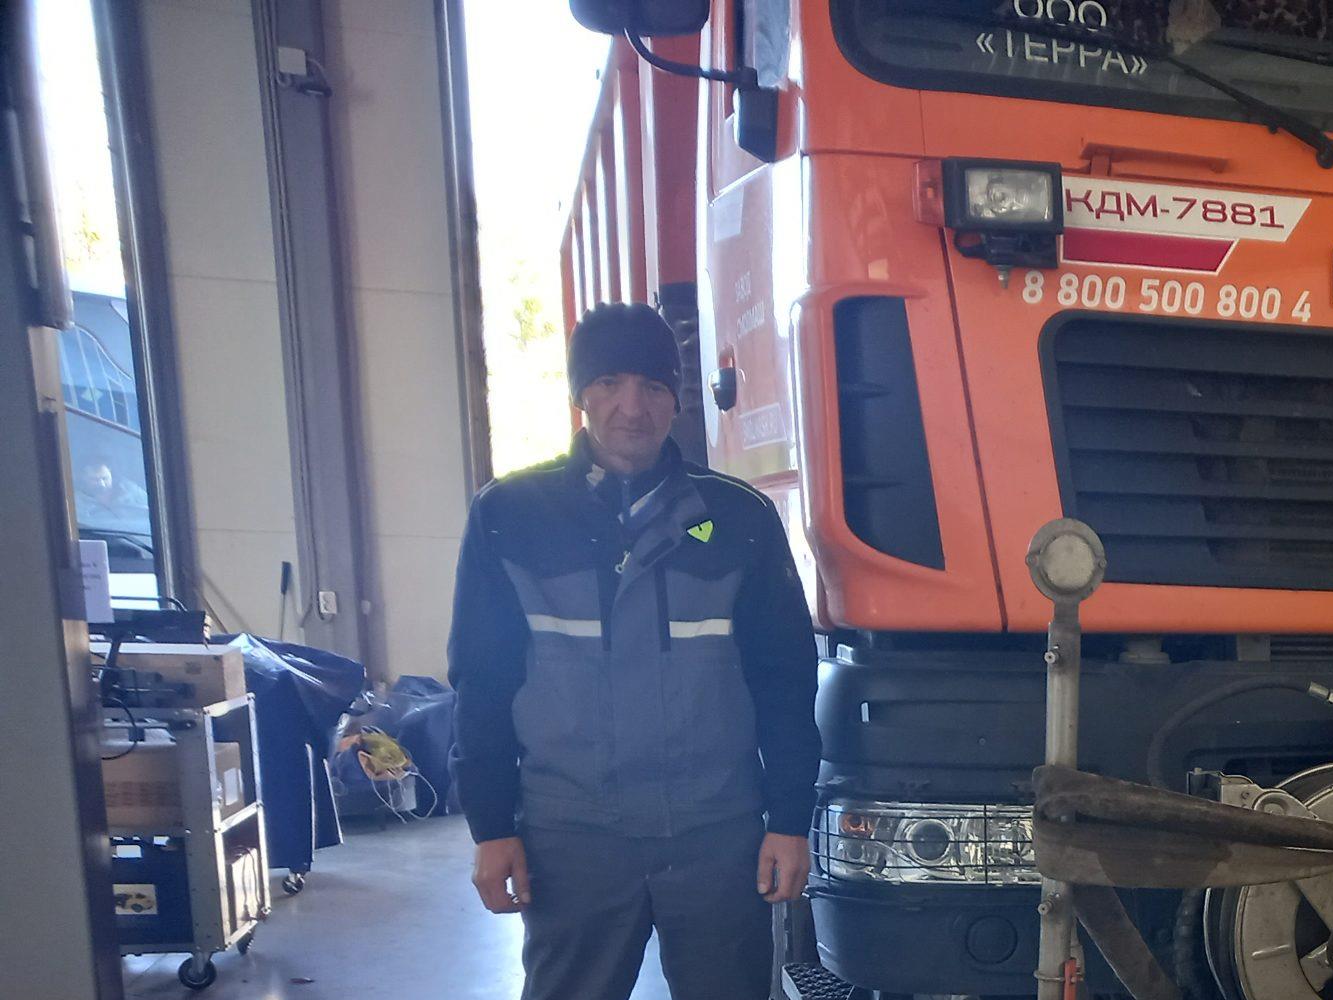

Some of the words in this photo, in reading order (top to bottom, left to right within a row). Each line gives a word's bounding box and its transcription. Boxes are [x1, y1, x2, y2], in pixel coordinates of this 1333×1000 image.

[1064, 188, 1285, 230] КДМ-7881
[1022, 270, 1045, 304] 8
[1057, 272, 1127, 310] 800
[1138, 278, 1205, 314] 500
[1216, 283, 1282, 320] 800
[1291, 290, 1313, 323] 4
